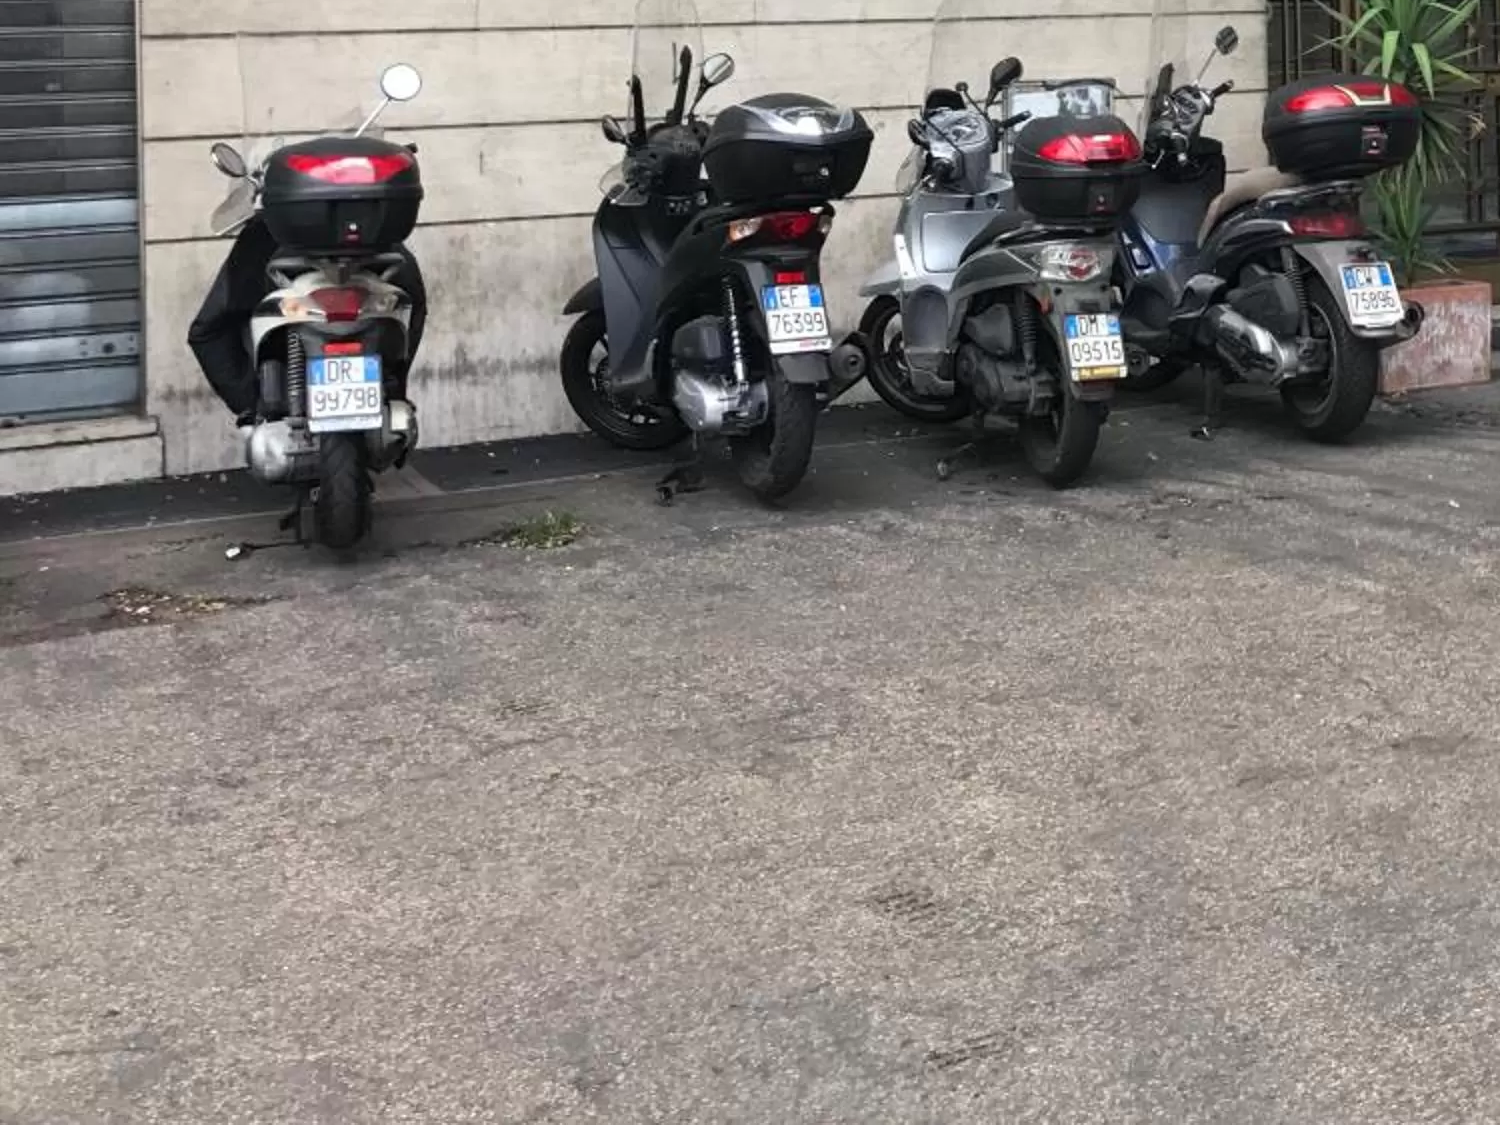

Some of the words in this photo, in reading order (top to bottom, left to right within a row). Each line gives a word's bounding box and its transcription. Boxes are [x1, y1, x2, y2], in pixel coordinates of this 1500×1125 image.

[778, 286, 799, 308] EF
[771, 312, 825, 334] 76399
[1078, 314, 1099, 336] DM
[1071, 339, 1121, 363] 09515
[327, 360, 353, 382] DR
[314, 386, 379, 412] 99798
